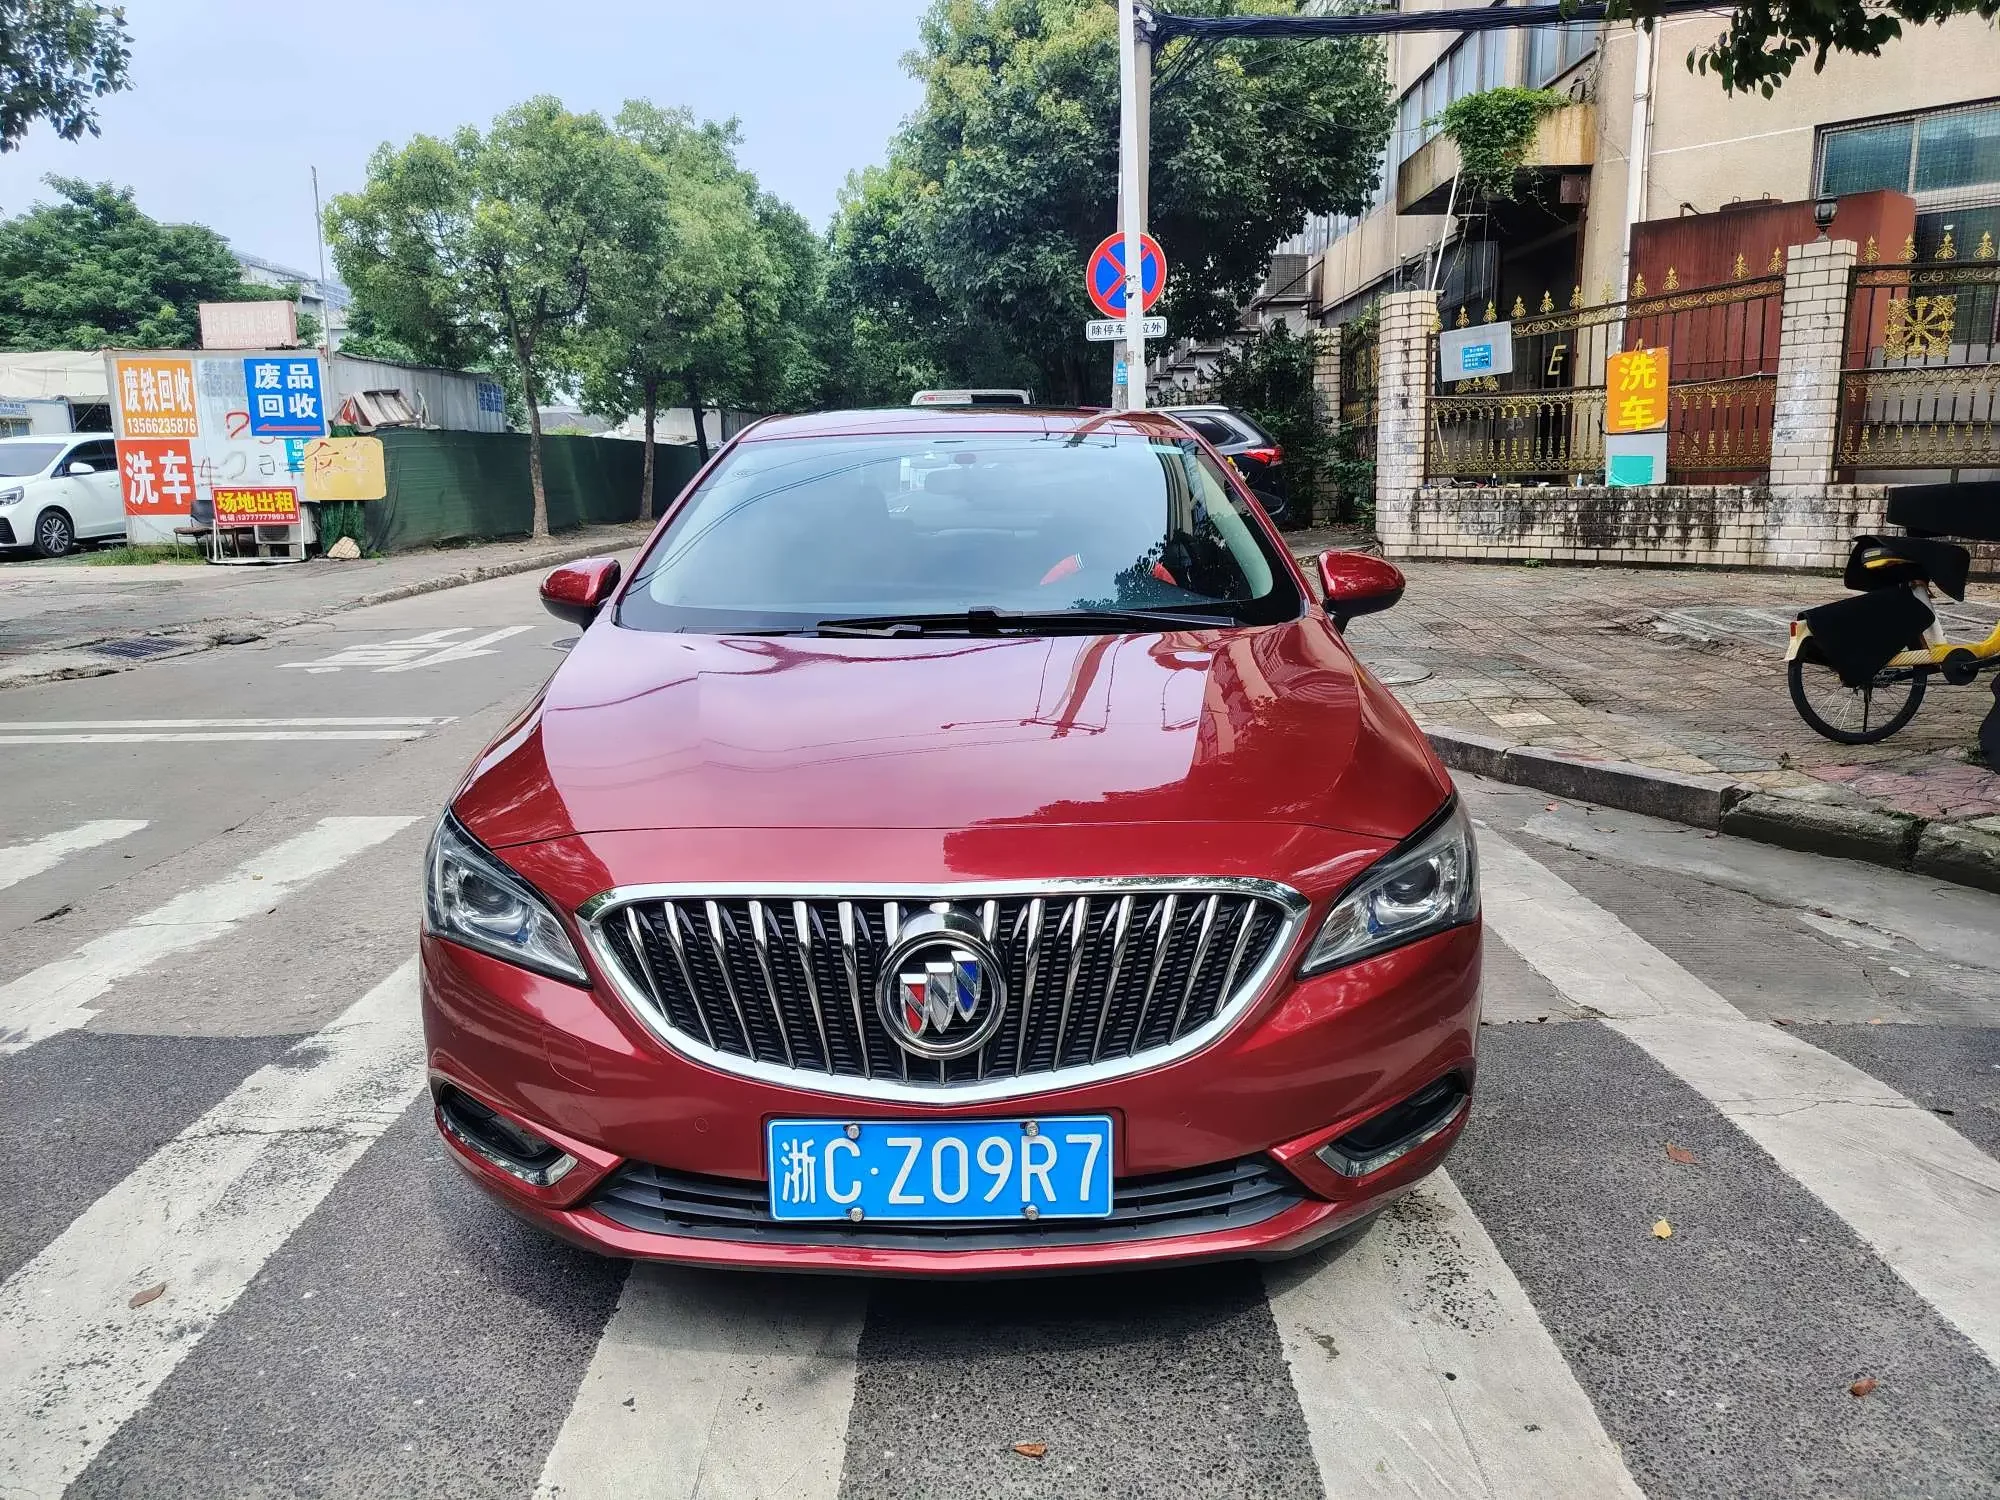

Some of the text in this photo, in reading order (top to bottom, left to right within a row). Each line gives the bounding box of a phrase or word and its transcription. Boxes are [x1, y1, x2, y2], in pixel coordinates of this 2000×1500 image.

[1091, 322, 1162, 337] 除停车位外
[122, 366, 193, 413] 废铁回收
[254, 363, 314, 390] 废品
[257, 392, 318, 419] 回收
[1618, 353, 1657, 431] 洗车
[127, 417, 197, 434] 13566235876
[125, 450, 192, 505] 洗车
[216, 490, 296, 513] 场地出租
